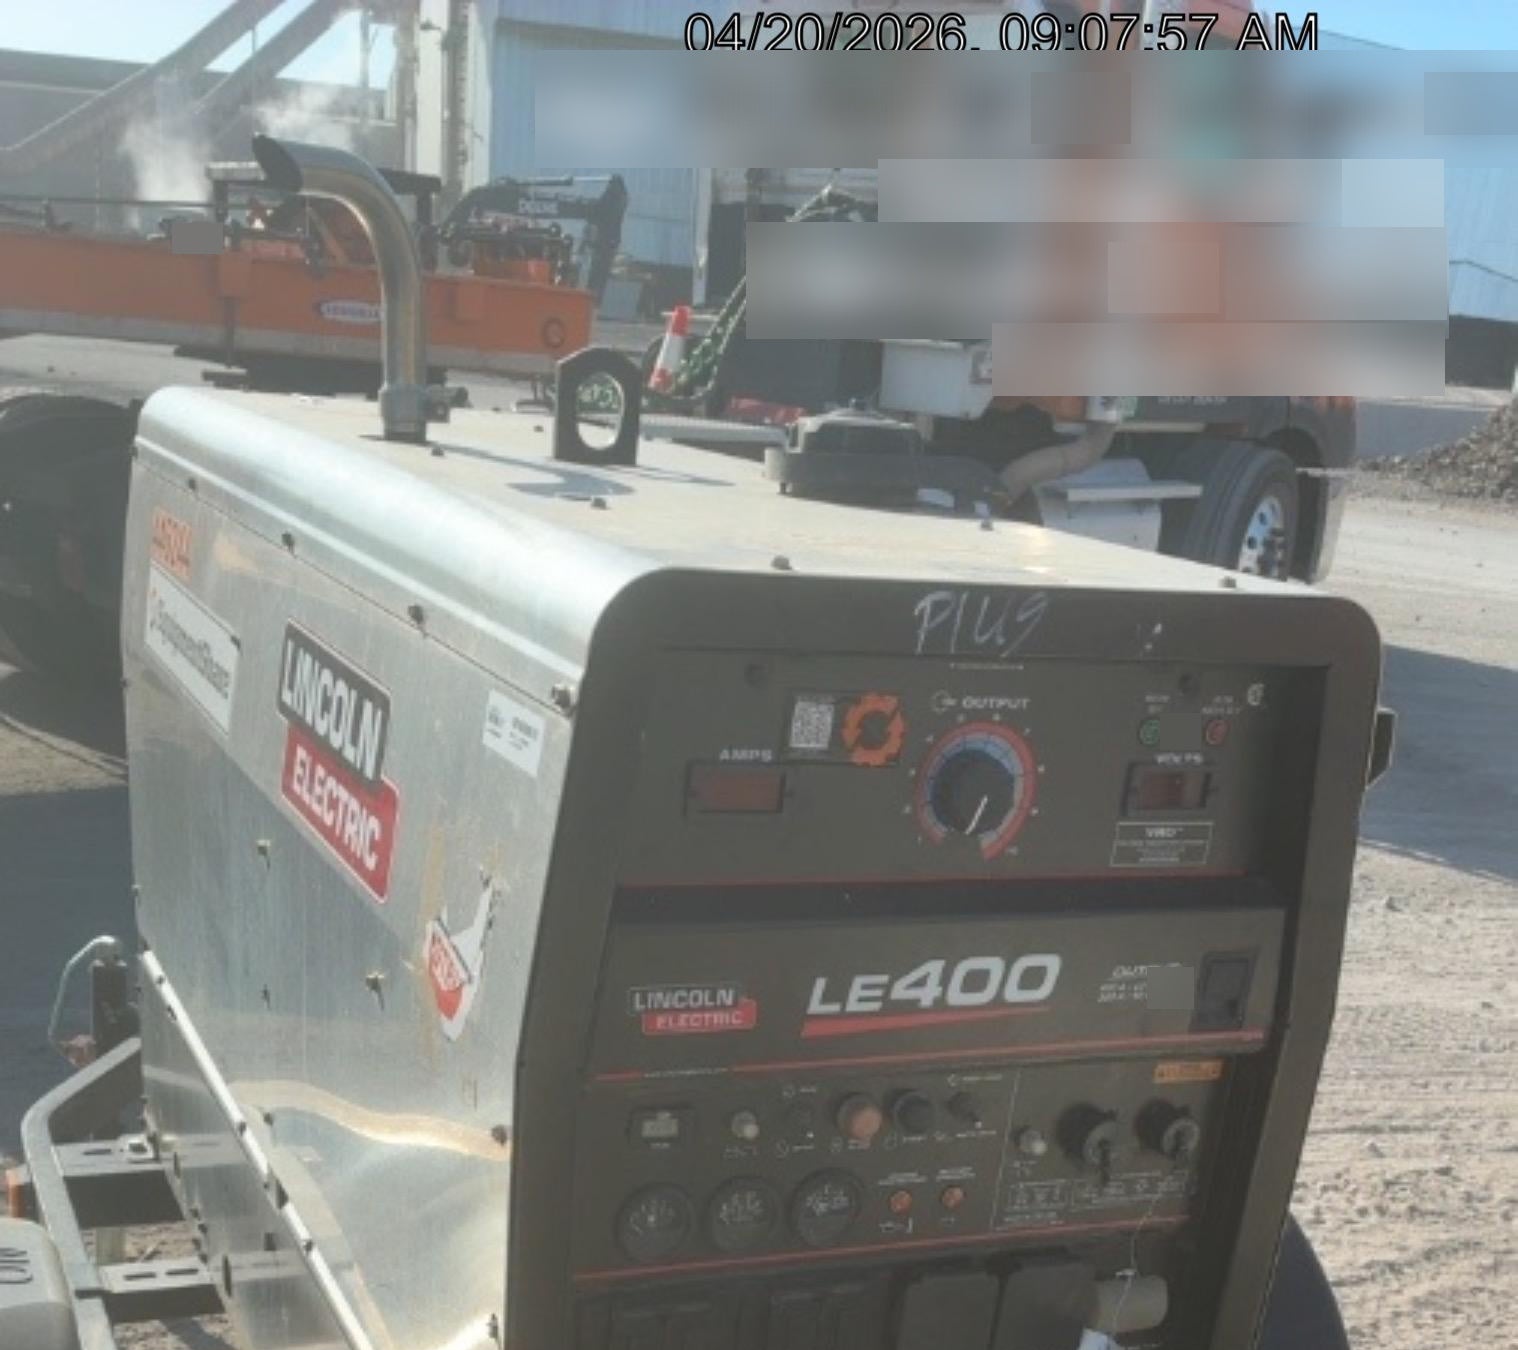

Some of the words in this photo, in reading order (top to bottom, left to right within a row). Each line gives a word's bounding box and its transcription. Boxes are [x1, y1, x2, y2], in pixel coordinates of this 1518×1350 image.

[281, 639, 383, 781] LINCOLN
[961, 695, 1032, 710] OUTPUT
[719, 747, 773, 762] AMPS
[291, 743, 382, 871] ELECTRIC
[806, 953, 1063, 1015] LE400
[634, 988, 735, 1011] LINCOLN
[656, 1009, 744, 1029] ELECTRIC
